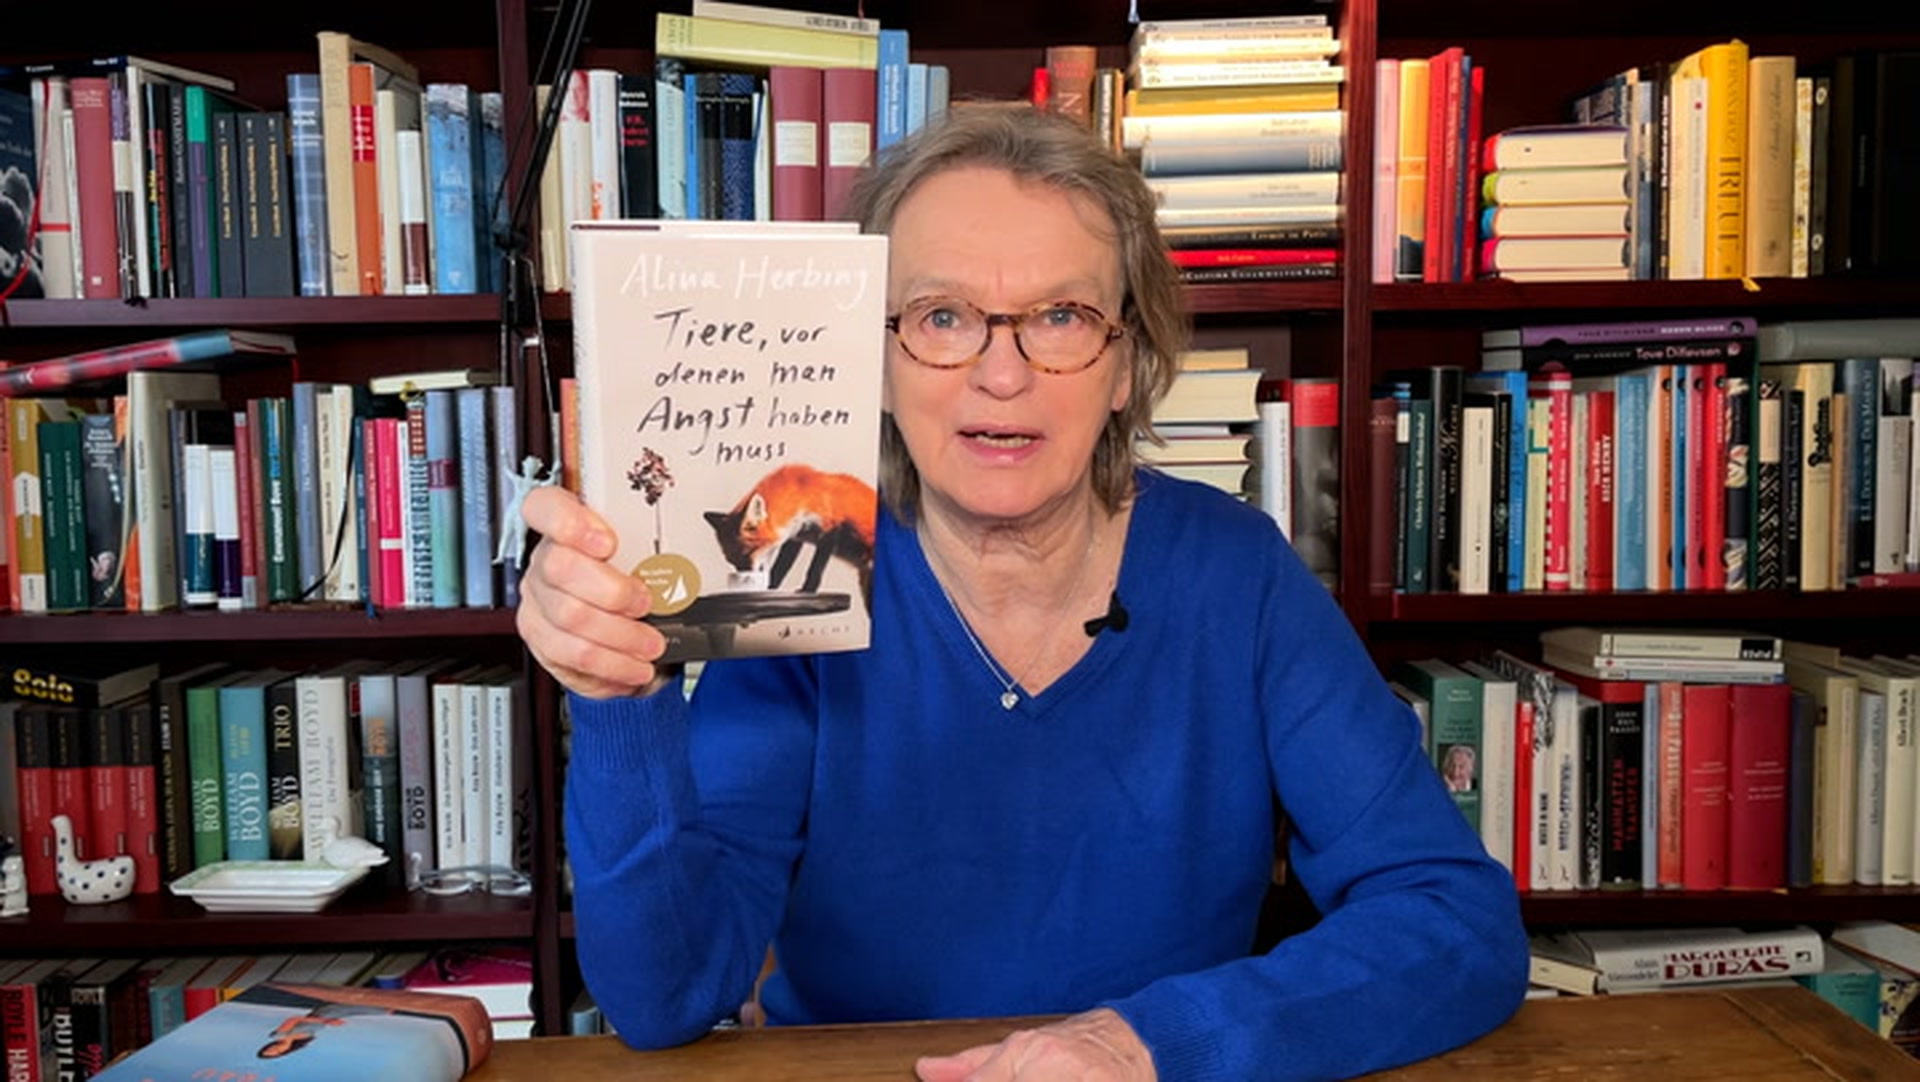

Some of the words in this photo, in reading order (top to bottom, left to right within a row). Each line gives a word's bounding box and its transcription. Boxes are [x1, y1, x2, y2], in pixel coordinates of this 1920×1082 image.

[619, 253, 722, 298] Alina
[734, 253, 870, 311] Herbing
[653, 306, 768, 352] Tiere,
[780, 322, 828, 347] vor
[654, 360, 746, 388] denen
[769, 360, 836, 386] man
[637, 394, 755, 457] Angst
[768, 396, 850, 430] haben
[715, 440, 788, 467] muss
[270, 479, 284, 504] Bove
[273, 704, 292, 751] TRIO
[303, 689, 321, 747] BOYD
[201, 777, 220, 831] BOYD
[239, 771, 262, 841] BOYD
[281, 776, 300, 829] BOYD
[412, 786, 425, 830] BOYD
[1612, 757, 1623, 851] MANHATTAN
[1663, 944, 1785, 964] MARGUERITE
[1663, 957, 1791, 981] DURAS
